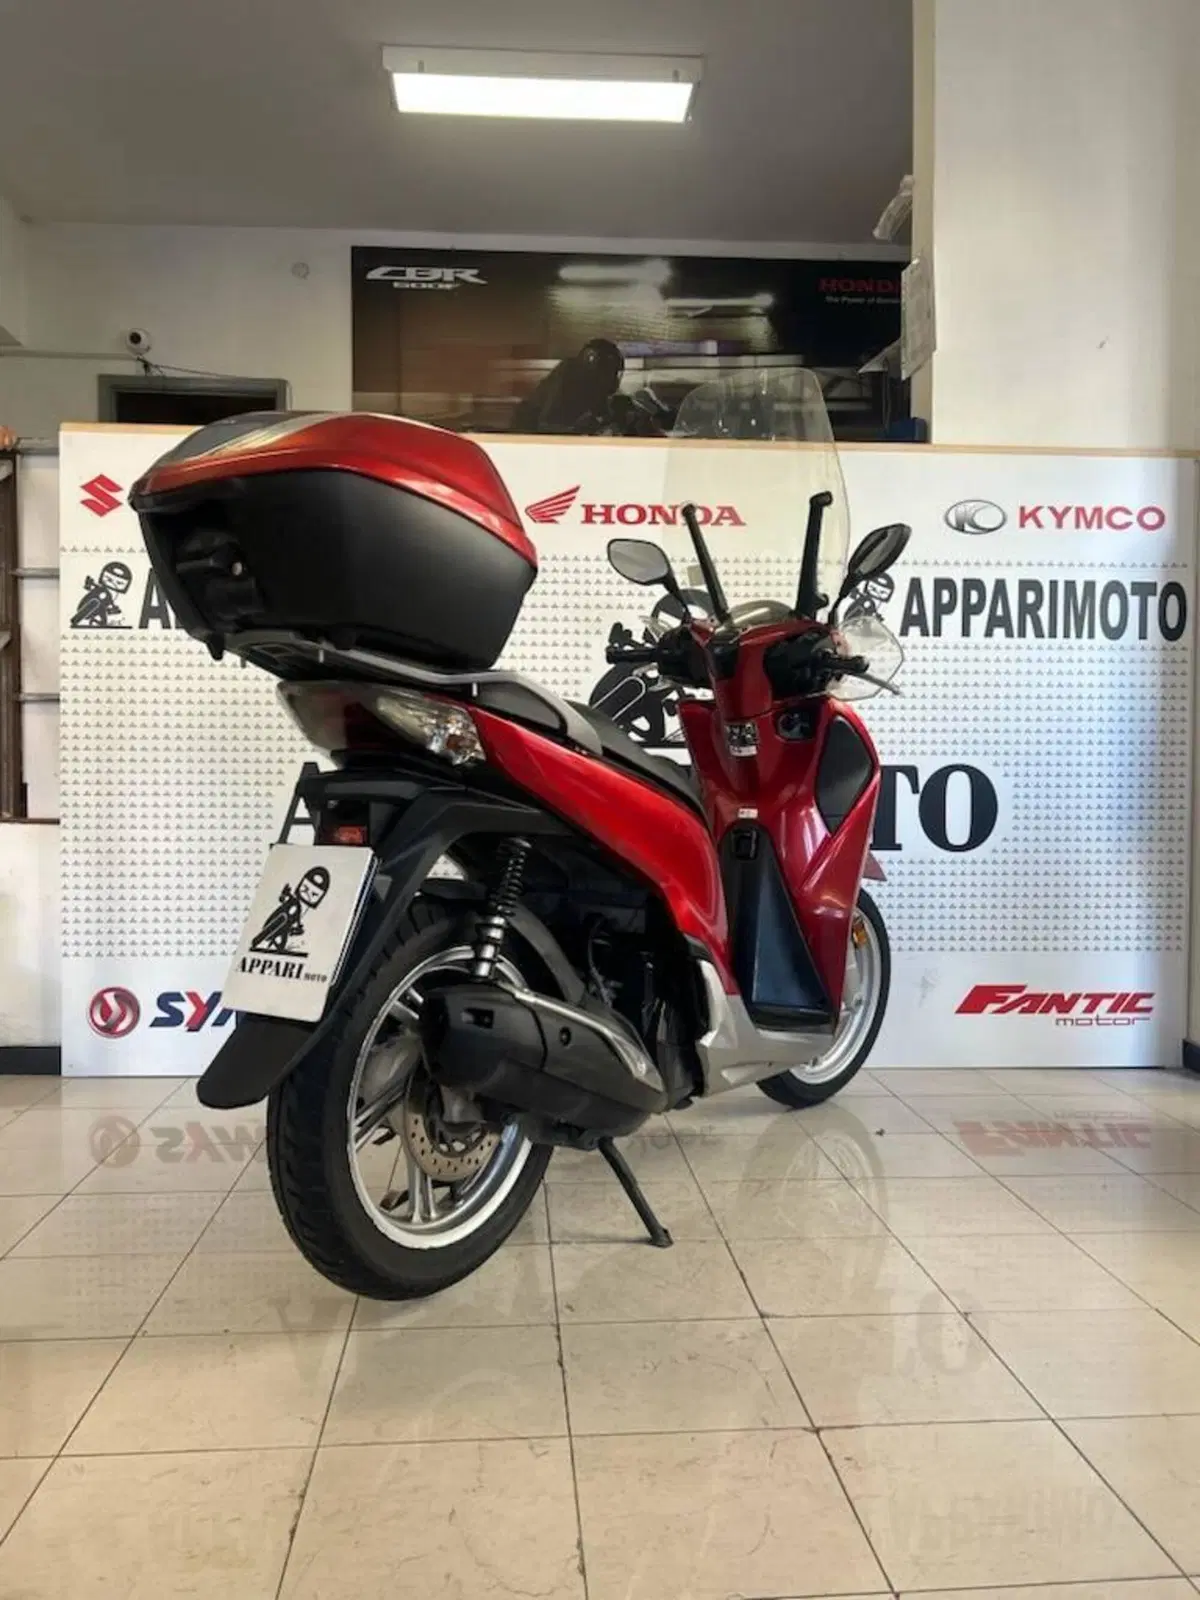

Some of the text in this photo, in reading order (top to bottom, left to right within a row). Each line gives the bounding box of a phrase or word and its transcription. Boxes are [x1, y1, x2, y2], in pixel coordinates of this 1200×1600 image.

[366, 266, 488, 284] CBR
[819, 278, 900, 292] HOND
[581, 504, 746, 525] HONDA
[1019, 506, 1165, 531] KYMCO
[899, 577, 1187, 641] APPARIMOTO
[870, 764, 998, 852] TO
[236, 957, 304, 979] APPARI
[955, 984, 1155, 1013] FANTIC
[149, 991, 235, 1032] SY
[1055, 1015, 1151, 1026] motor
